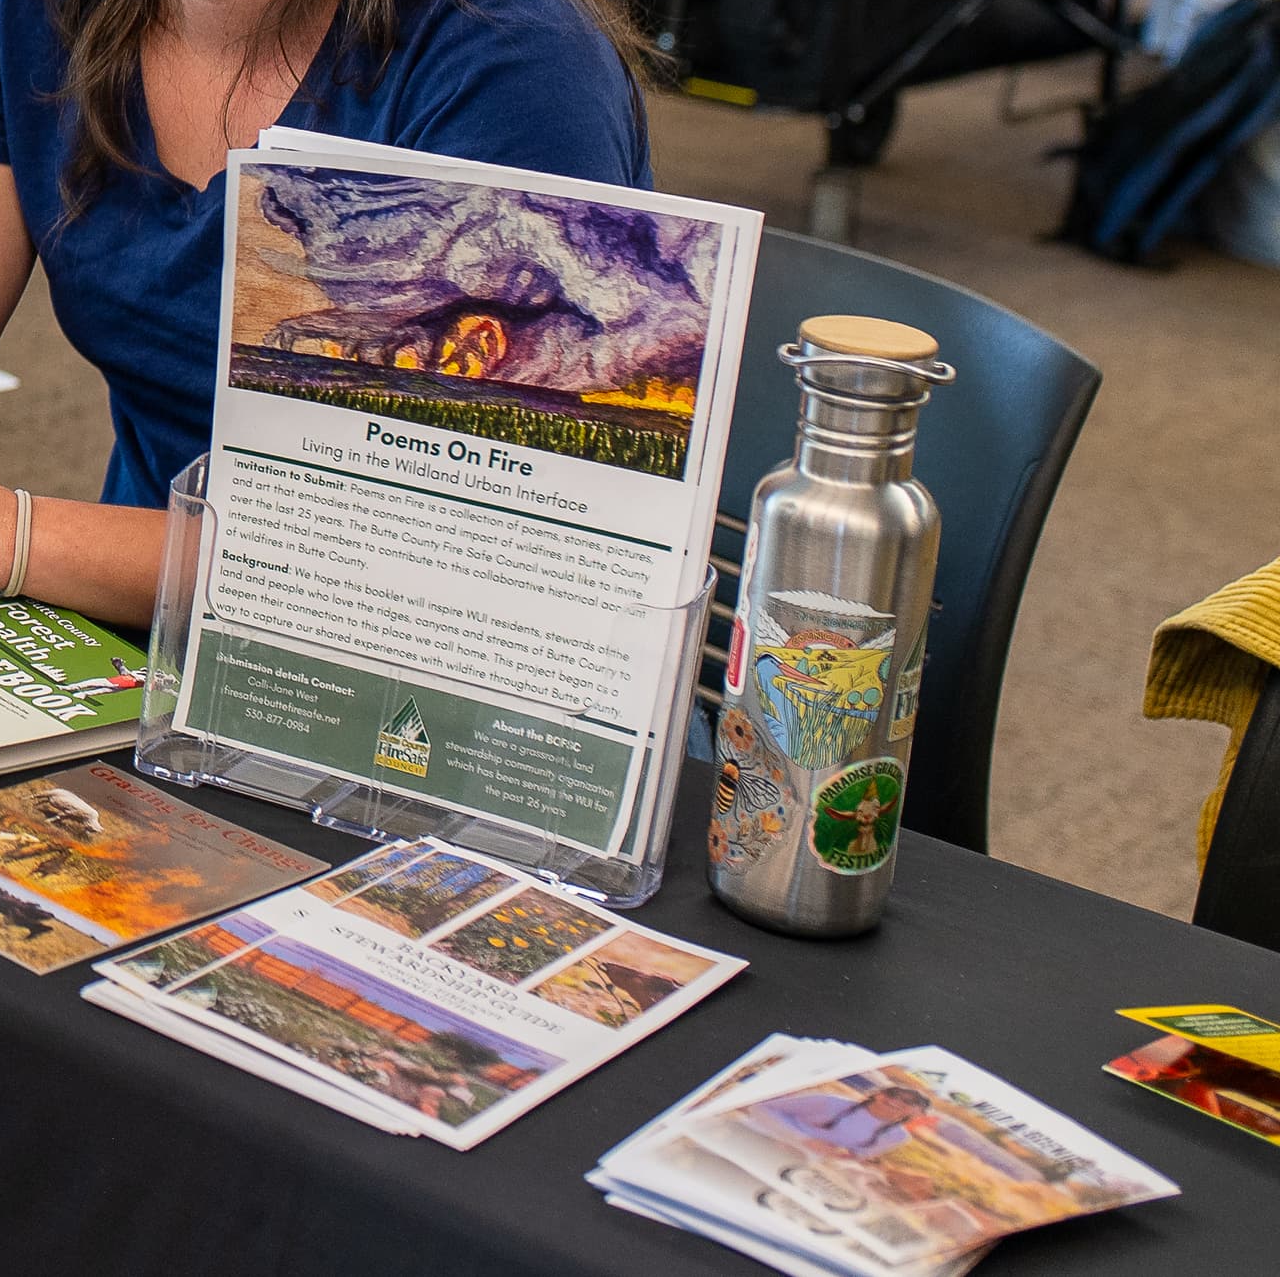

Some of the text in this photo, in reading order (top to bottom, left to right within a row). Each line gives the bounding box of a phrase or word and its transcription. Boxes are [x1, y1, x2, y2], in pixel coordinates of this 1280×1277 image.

[301, 436, 588, 513] Living in the Wildland Urban Interface
[365, 420, 533, 476] Poems On Fire
[231, 476, 648, 581] and art that embodies the connection and impact of wildfires in Butte County
[233, 457, 653, 564] Invitation to Submit: Poems on Fire is a collection of poems, stories, pictures,
[225, 525, 365, 570] of wildfires in Butte County.
[227, 509, 646, 615] interested tribal members to contribute to this collaborative historical accunt
[229, 494, 643, 604] over the last 25 years. The Butte County Fire Safe Council would like to invite
[27, 600, 102, 647] utte County
[272, 666, 309, 685] details
[310, 676, 355, 697] Contact:
[295, 688, 318, 703] West
[378, 741, 428, 767] FireSafe
[491, 719, 525, 737] About
[525, 727, 544, 742] the
[820, 765, 873, 802] PARADISE
[91, 766, 179, 814] Grazing
[183, 812, 220, 831] for
[222, 829, 311, 873] Change
[330, 925, 488, 1002] STEWARDSHIP
[489, 999, 566, 1035] GUIDE
[397, 941, 519, 1002] BACKYARD
